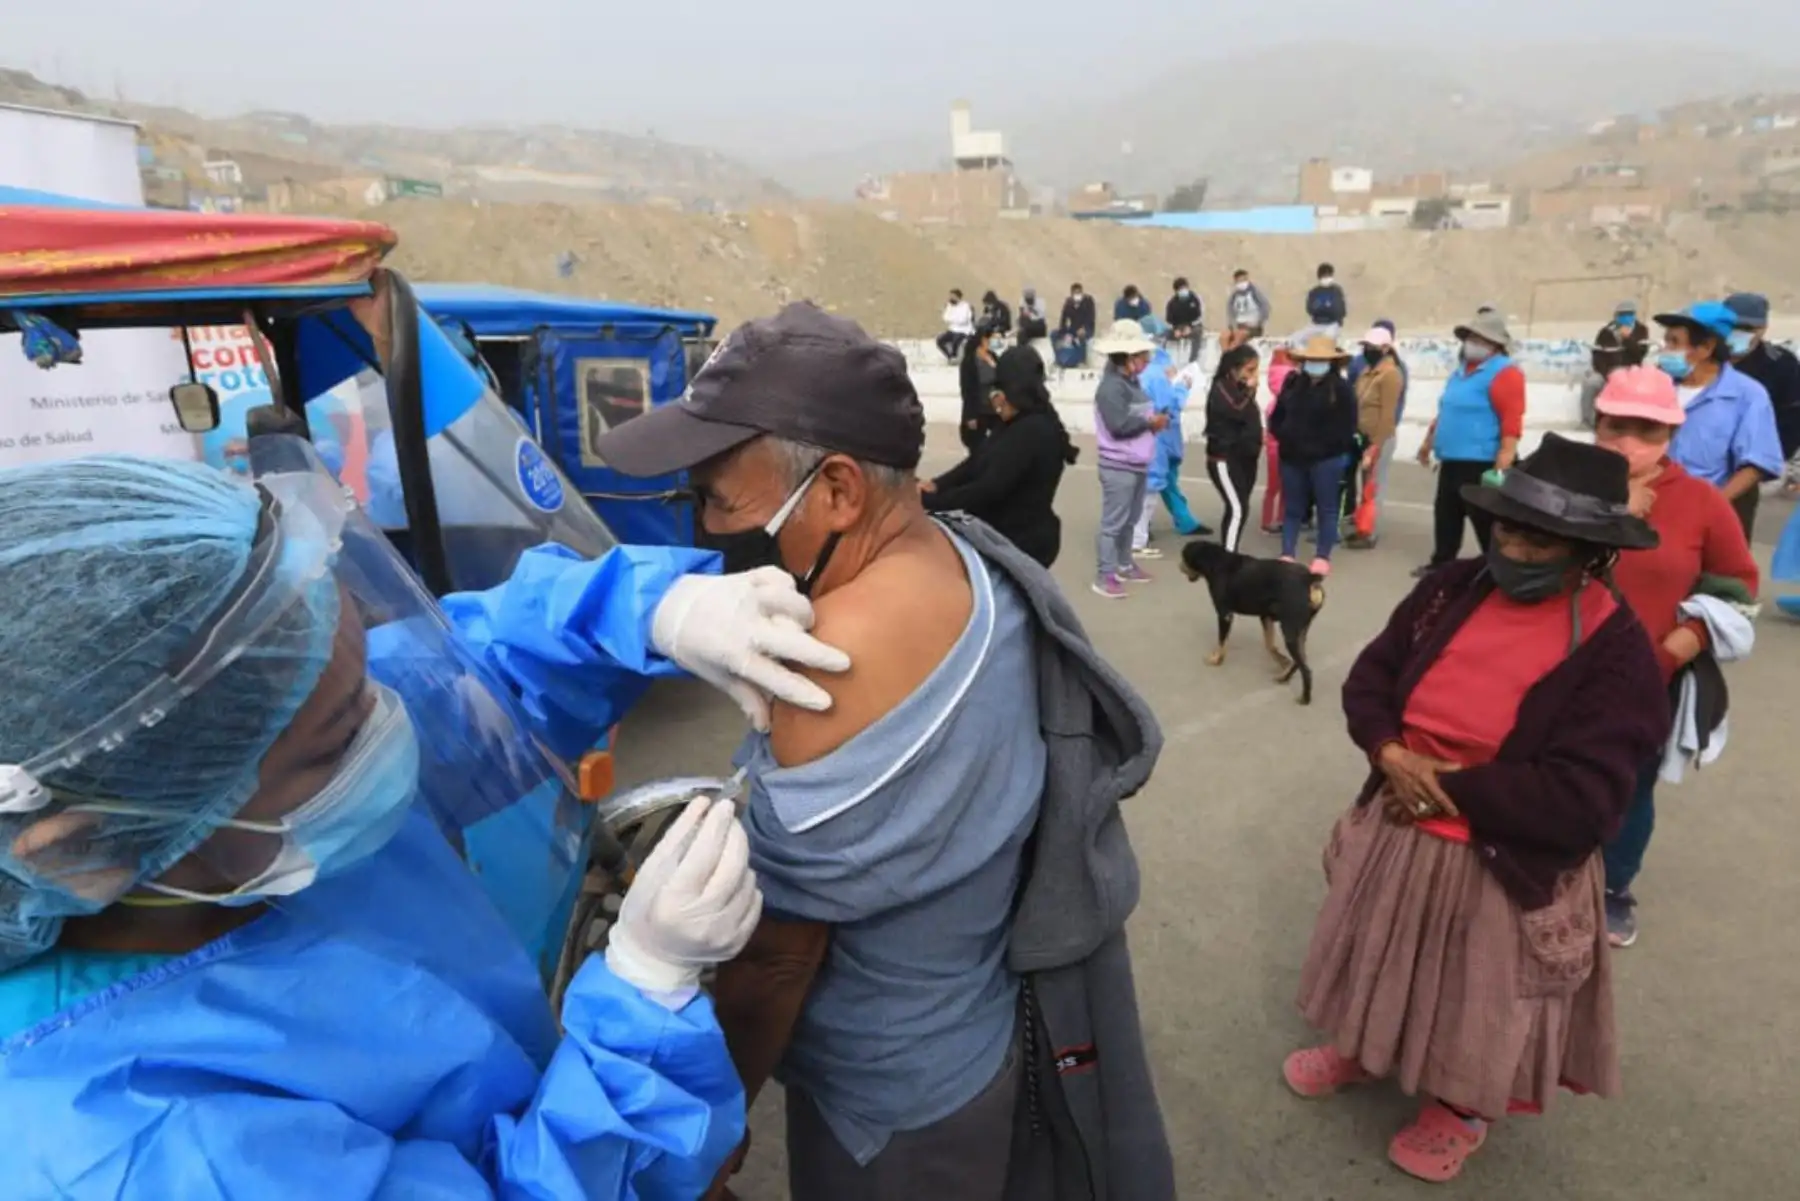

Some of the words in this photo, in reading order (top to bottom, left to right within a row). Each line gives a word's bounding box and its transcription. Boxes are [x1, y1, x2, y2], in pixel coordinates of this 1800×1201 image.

[29, 395, 118, 410] Ministerio
[121, 391, 142, 404] de
[20, 432, 42, 447] de
[44, 428, 94, 446] Salud
